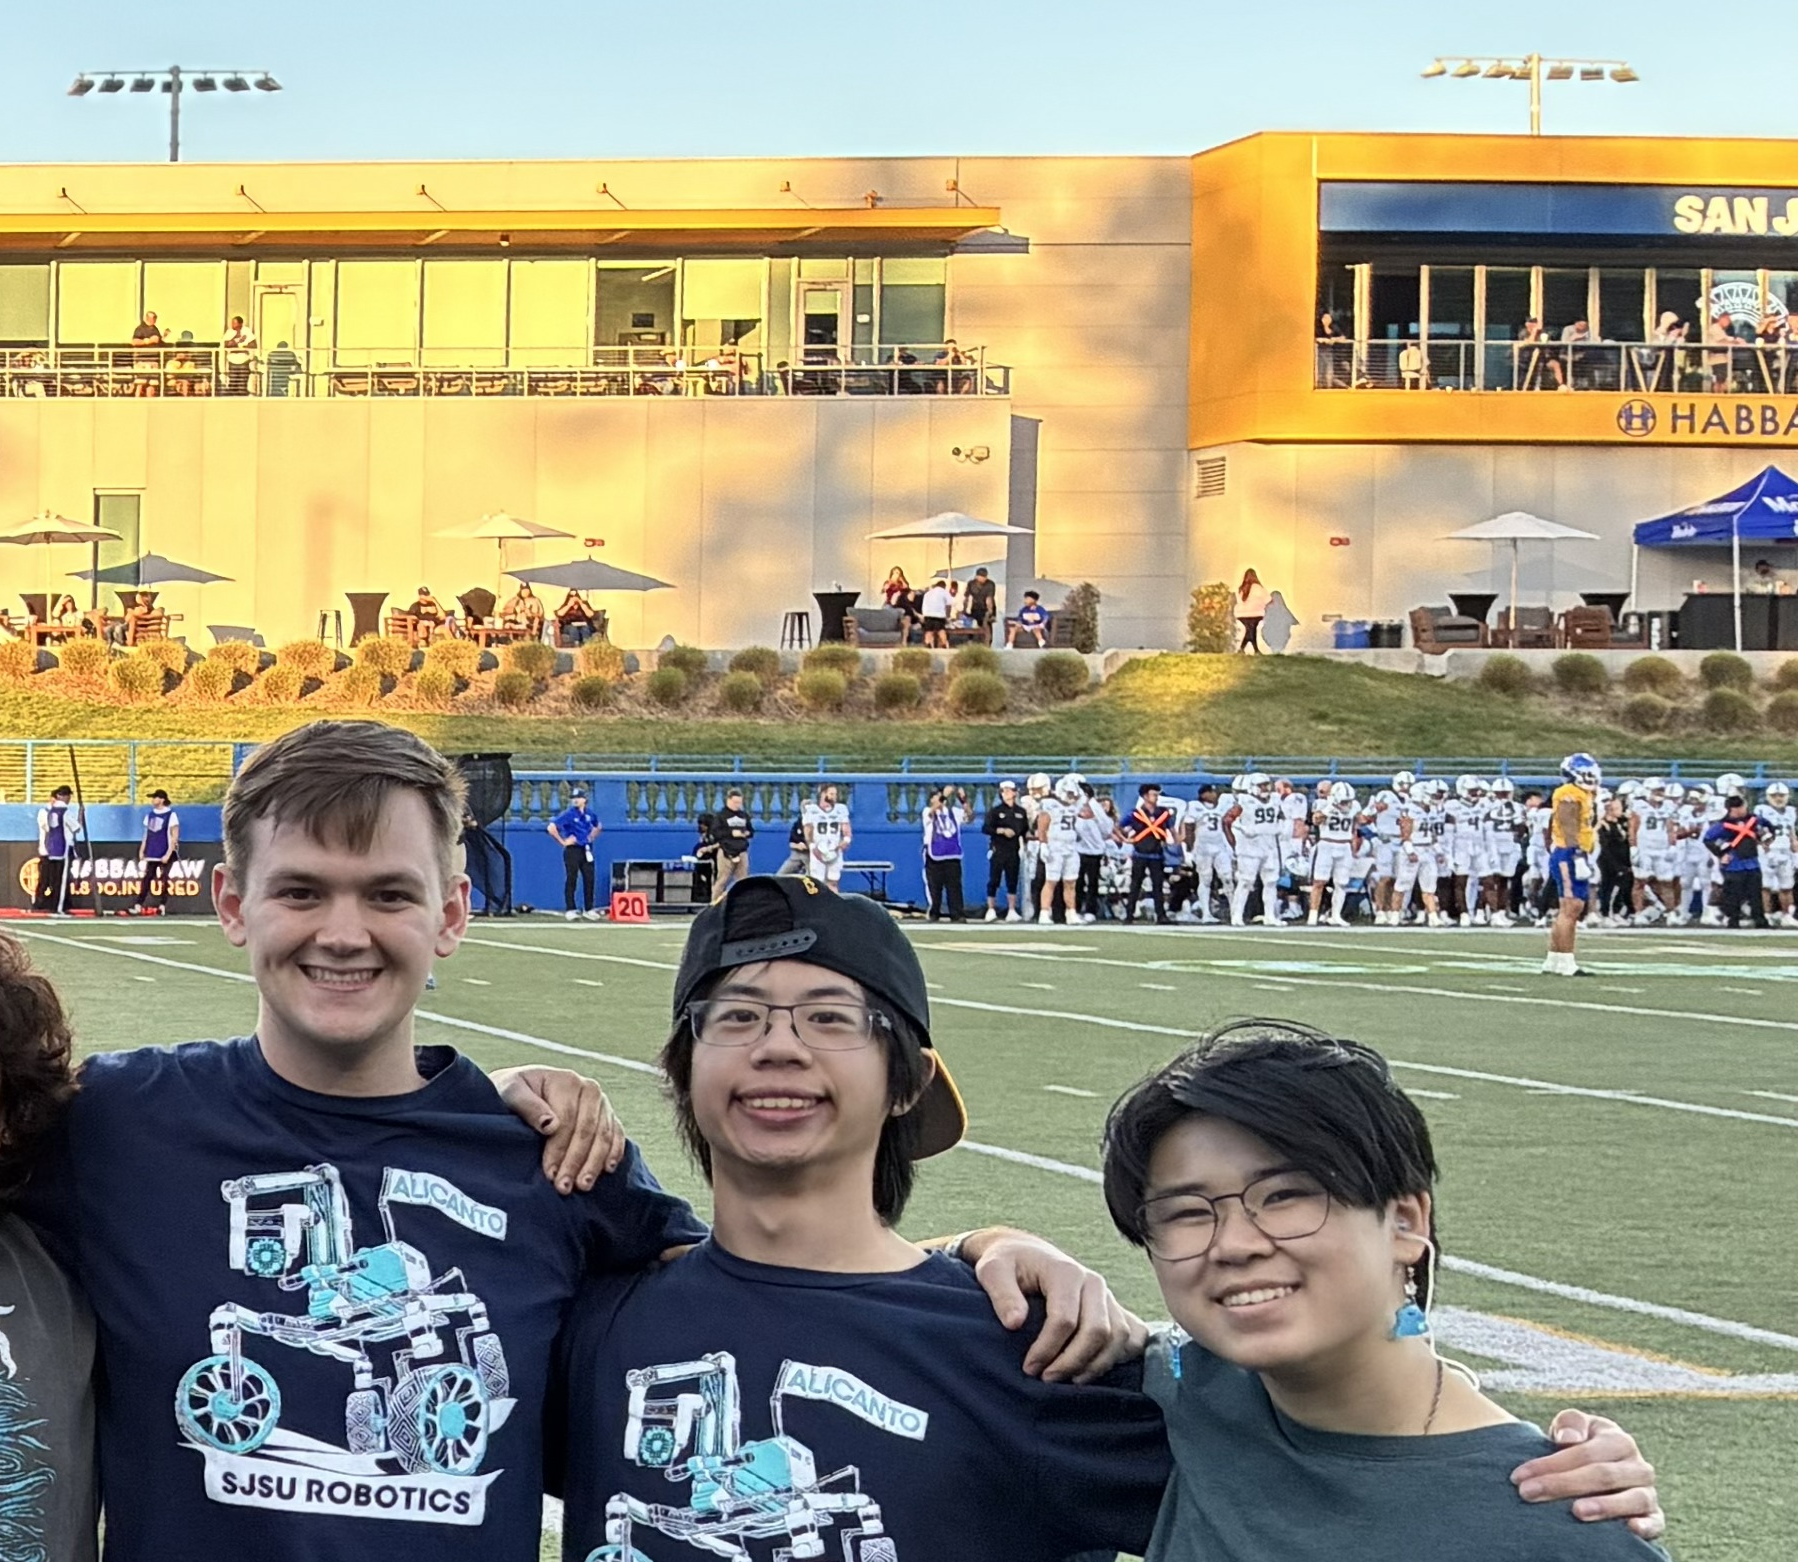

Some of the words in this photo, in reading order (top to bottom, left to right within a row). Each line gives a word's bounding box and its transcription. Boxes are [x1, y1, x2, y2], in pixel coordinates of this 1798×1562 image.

[1673, 194, 1770, 235] SAN
[1254, 807, 1275, 825] 99
[1328, 816, 1350, 832] 20
[617, 897, 644, 917] 20
[392, 1173, 505, 1234] ALICANTO
[787, 1368, 921, 1434] ALICANTO
[221, 1471, 298, 1500] SJSU
[306, 1478, 472, 1515] ROBOTICS
